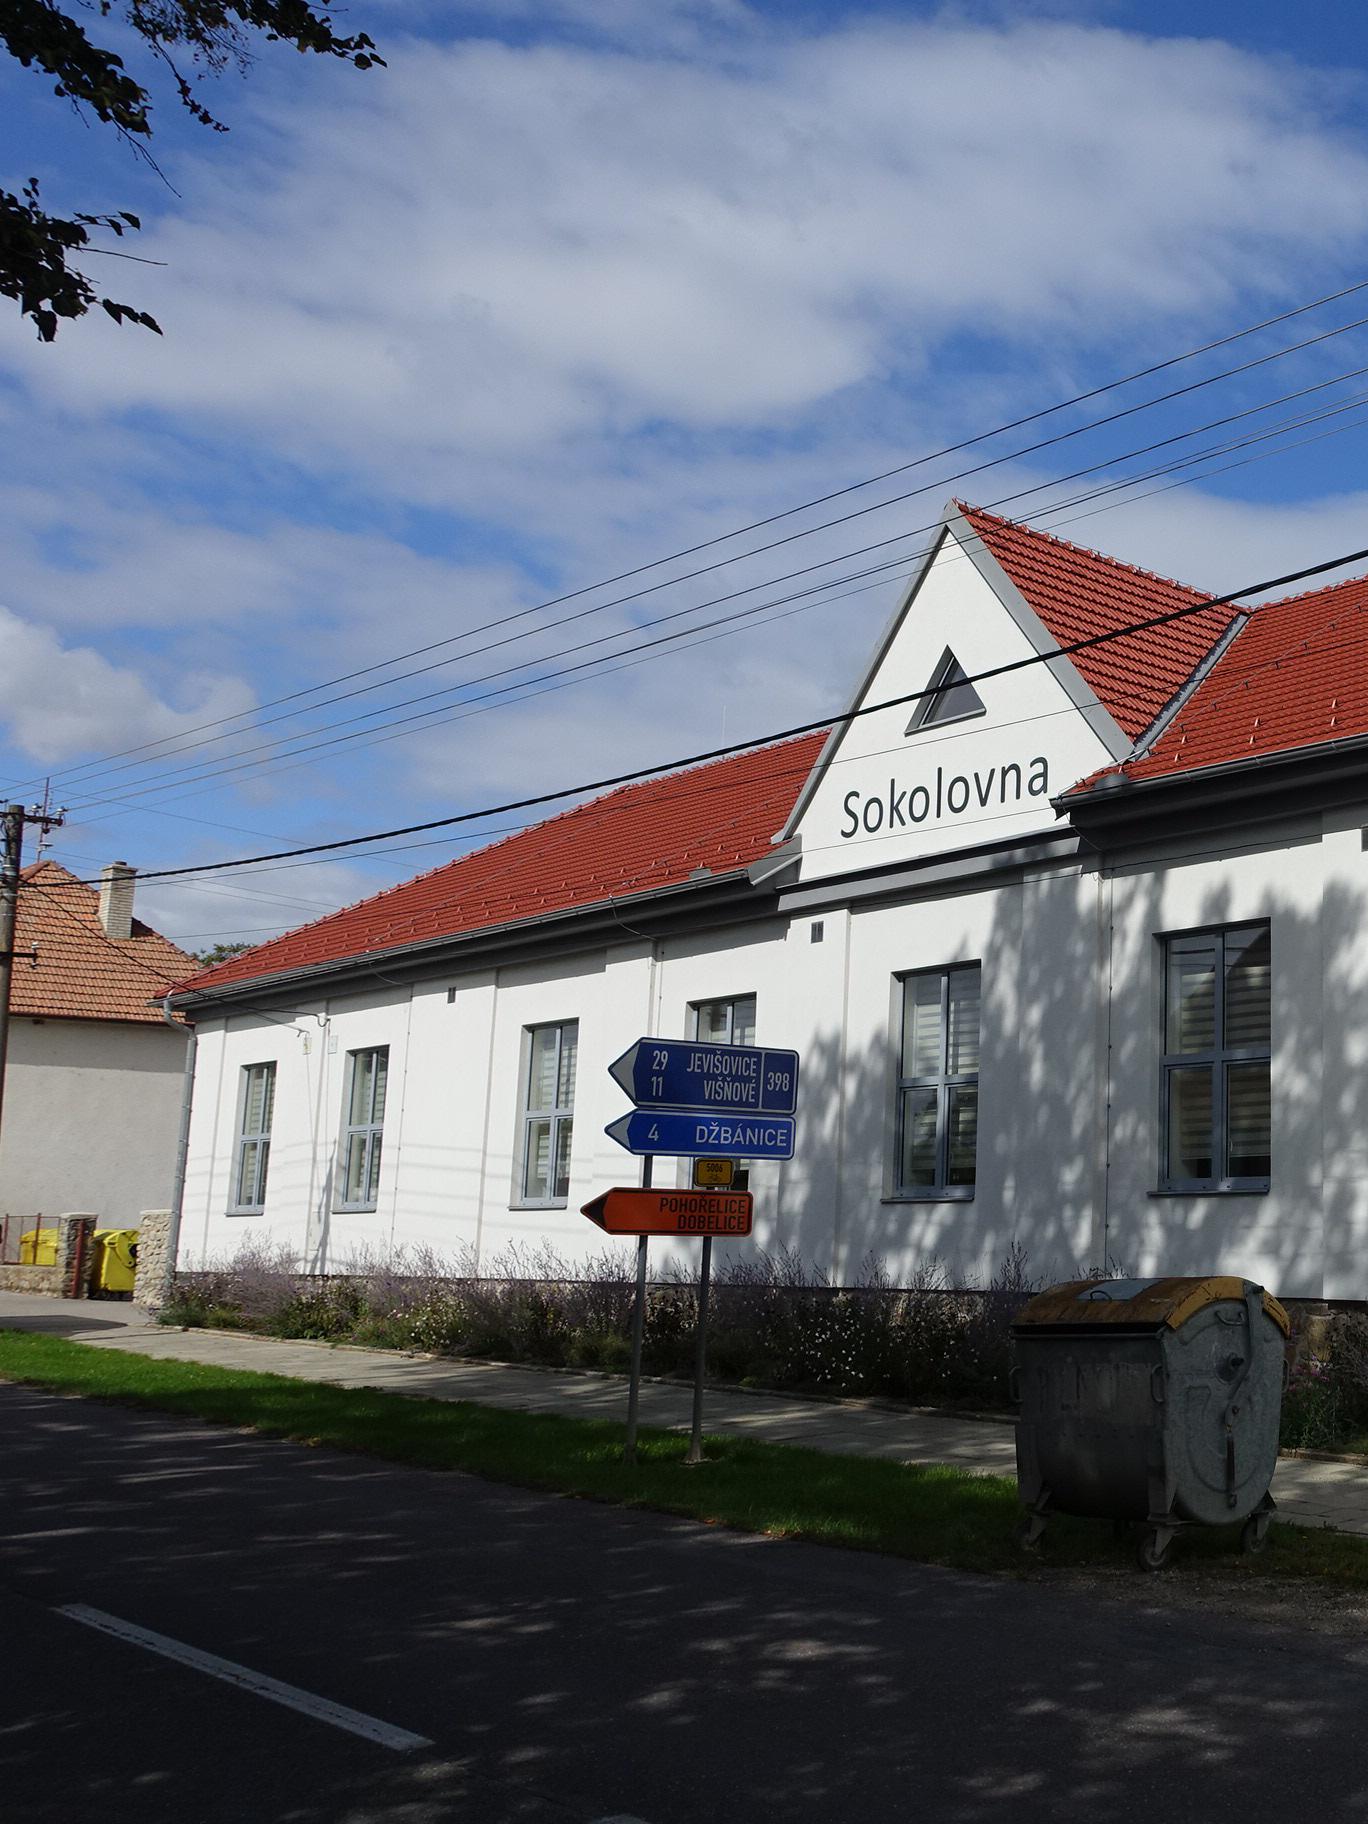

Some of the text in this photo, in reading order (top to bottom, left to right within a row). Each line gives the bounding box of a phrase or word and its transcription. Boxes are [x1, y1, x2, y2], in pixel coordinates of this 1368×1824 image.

[840, 756, 1049, 838] Sokolovna
[652, 1050, 758, 1077] 29 JEVIŠOVICE
[651, 1076, 756, 1102] 11 VIŠŇOVÉ
[767, 1072, 790, 1092] 398
[647, 1121, 788, 1146] 4 DŽBÁNICE
[677, 1214, 745, 1231] DOBELICE
